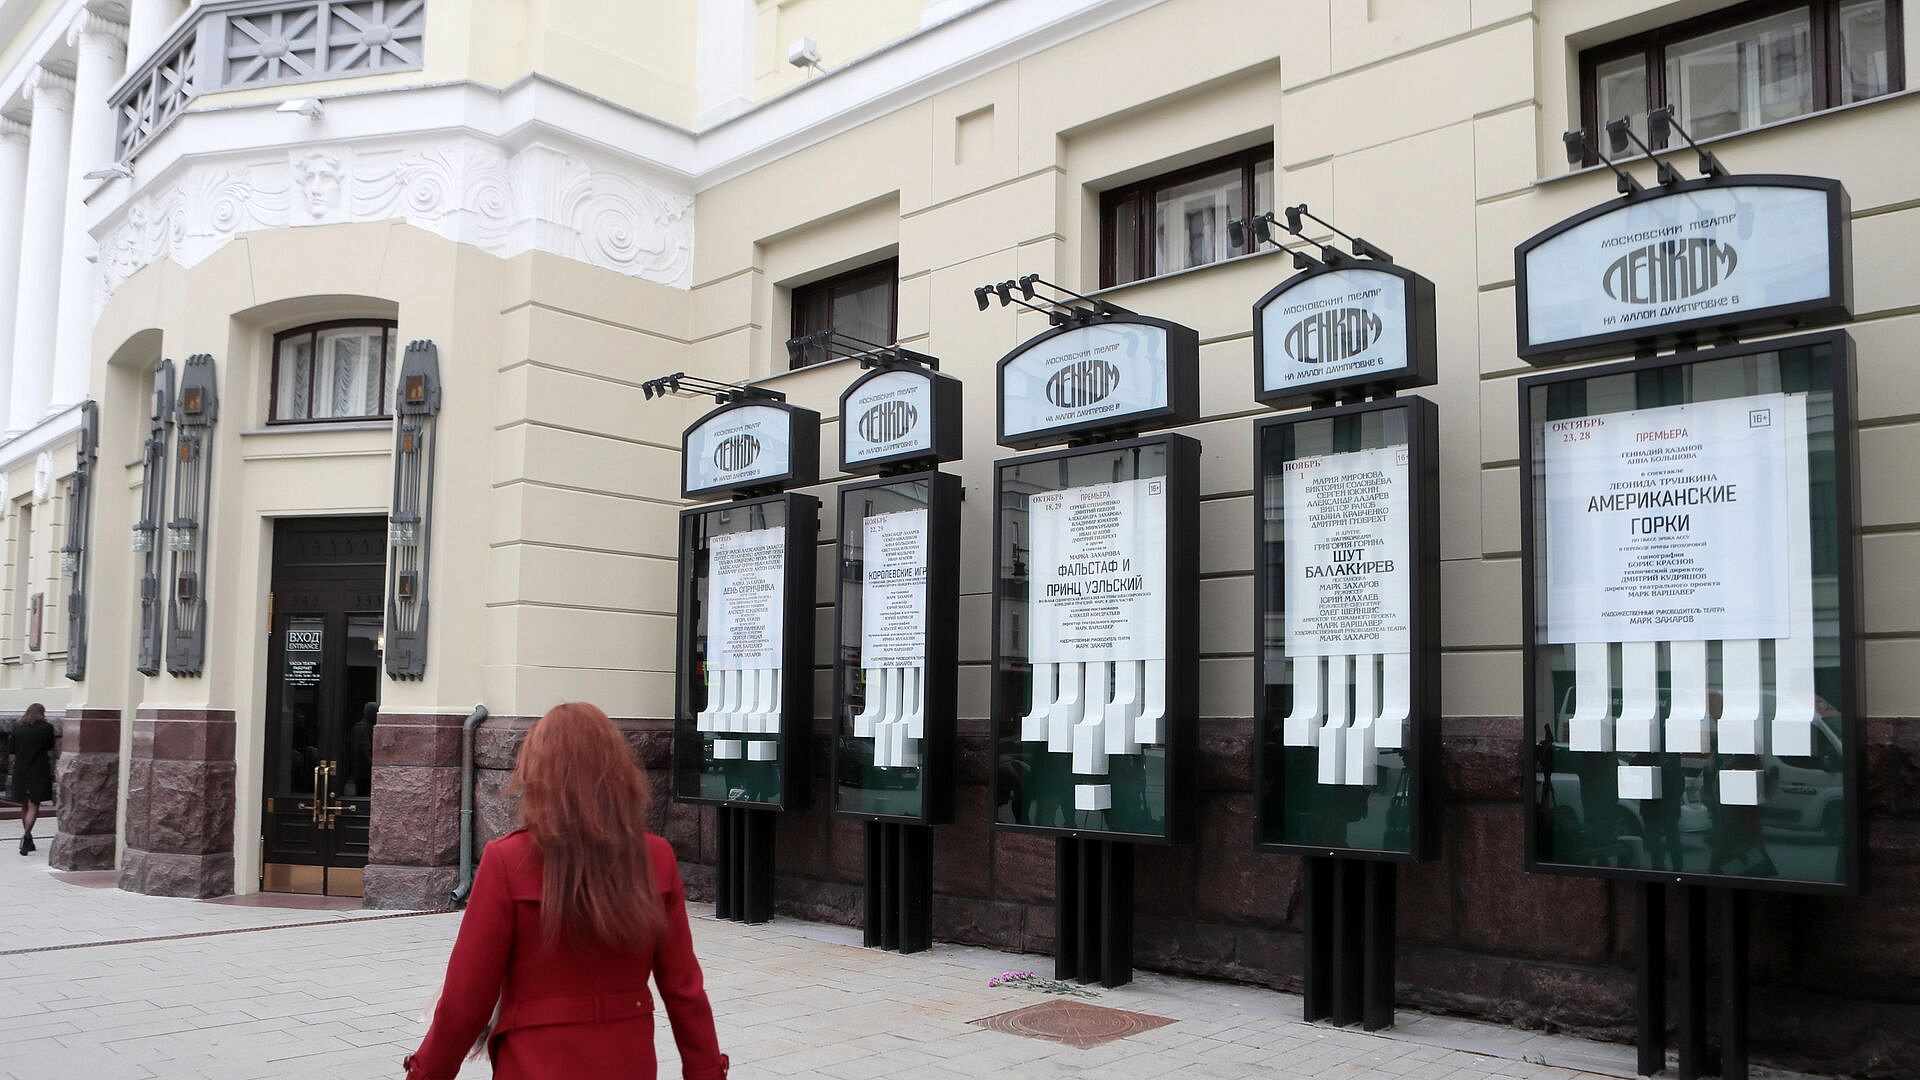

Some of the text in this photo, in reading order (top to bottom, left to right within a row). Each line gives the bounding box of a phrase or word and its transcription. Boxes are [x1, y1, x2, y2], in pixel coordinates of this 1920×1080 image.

[1603, 238, 1738, 304] ЛЕНКОМ
[1604, 316, 1616, 326] НА
[1660, 297, 1728, 316] ДМИТРОВКЕ
[1732, 296, 1739, 304] 6
[1284, 308, 1382, 364] ЛЕНКОМ
[1326, 358, 1376, 374] ДМИТРОВКЕ
[1046, 360, 1120, 408] ЛЕНКОМ
[859, 400, 918, 443] ЛЕНКОМ
[1552, 418, 1605, 432] ОКТЯБРЬ
[1752, 414, 1768, 424] 16+
[1563, 432, 1590, 443] 23, 28
[1636, 428, 1688, 442] ПРЕМЬЕРА
[714, 434, 760, 471] ЛЕНКОМ
[1621, 444, 1703, 458] ГЕННАДИЙ ХАЗАНОВ
[1627, 452, 1696, 464] АННА БОЛЬШОВА
[1285, 460, 1321, 472] НОЯБРЬ
[1306, 478, 1392, 493] ВИКТОРИЯ СОЛОВЬЕВА
[1312, 471, 1384, 486] МАРИЯ МИРОНОВА
[1610, 474, 1718, 490] ЛЕОНИДА ТРУШКИНА
[1032, 494, 1064, 504] ОКТЯБРЬ
[1080, 491, 1110, 502] ПРЕМЬЕРА
[1306, 492, 1390, 508] АЛЕКСАНДР ЛАЗАРЕВ
[1588, 485, 1736, 512] АМЕРИКАНСКИЕ
[1308, 507, 1389, 522] ТАТЬЯНА КРАВЧЕНКО
[1320, 502, 1376, 514] ВИКТОР РАКОВ
[1632, 514, 1690, 535] ГОРКИ
[1314, 538, 1384, 550] ГРИГОРИЯ ГОРИНА
[1091, 550, 1120, 558] ЗАХАРОВА
[1333, 548, 1364, 562] ШУТ
[869, 568, 912, 580] КОРОЛЕВСКИЕ
[1058, 558, 1130, 576] ФАЛЬСТАФ И
[1305, 560, 1395, 578] БАЛАКИРЕВ
[1046, 574, 1142, 596] ПРИНЦ УЭЛЬСКИЙ
[1342, 580, 1380, 589] ЗАХАРОВ
[1621, 574, 1658, 583] ДМИТРИЙ
[1344, 594, 1378, 602] МАХАЕВ
[1320, 608, 1340, 616] ОЛЕГ
[1316, 620, 1382, 630] МАРК ВАРШАВЕР
[1655, 616, 1694, 624] ЗАХАРОВ
[290, 632, 320, 643] ВХОД
